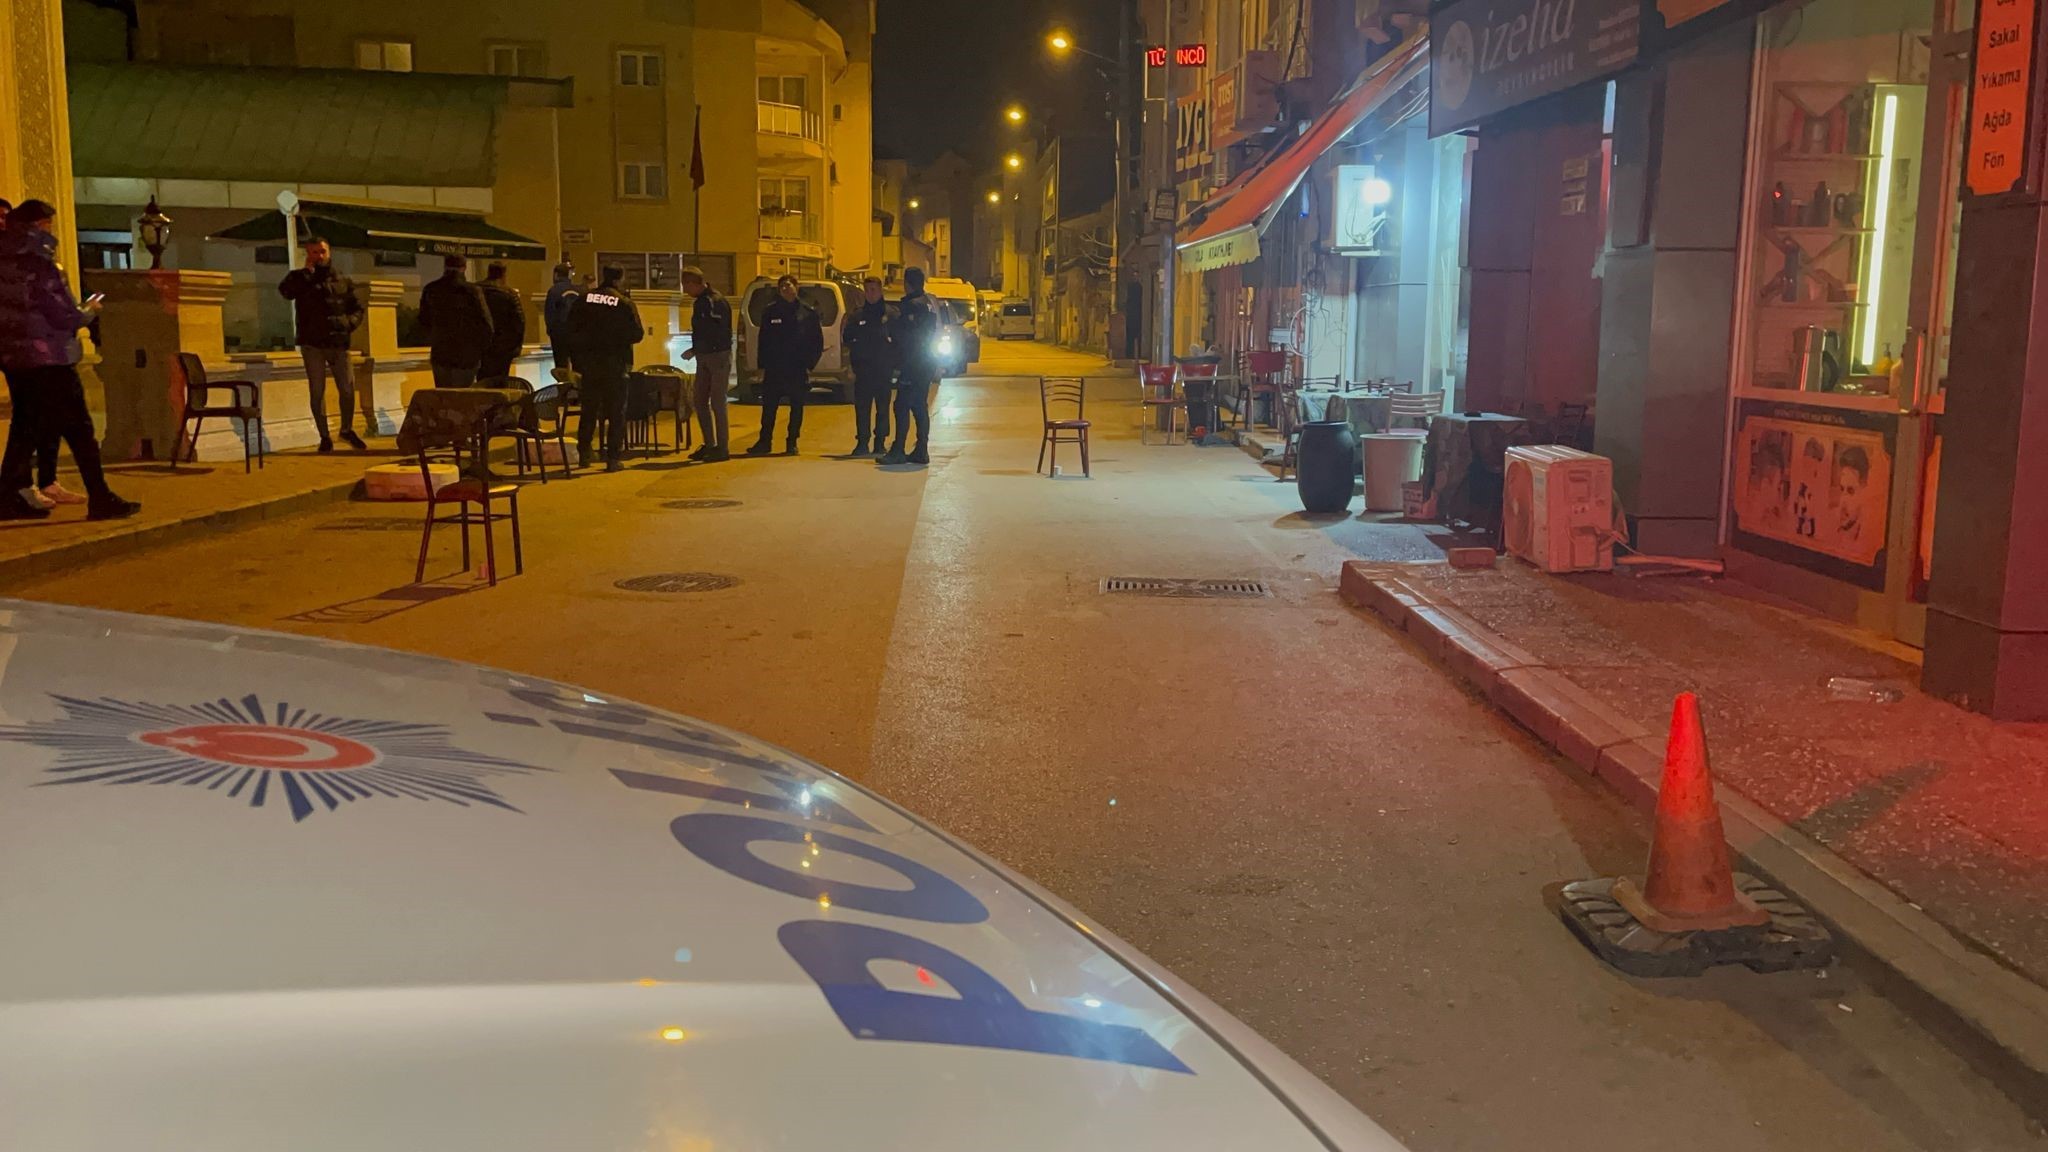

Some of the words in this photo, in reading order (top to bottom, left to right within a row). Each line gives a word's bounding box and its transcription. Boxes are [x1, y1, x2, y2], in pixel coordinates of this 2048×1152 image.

[1989, 25, 2020, 48] Sakal
[1981, 69, 2021, 90] Yıkama
[1982, 109, 2012, 133] Ağda
[1983, 152, 2005, 170] Fön
